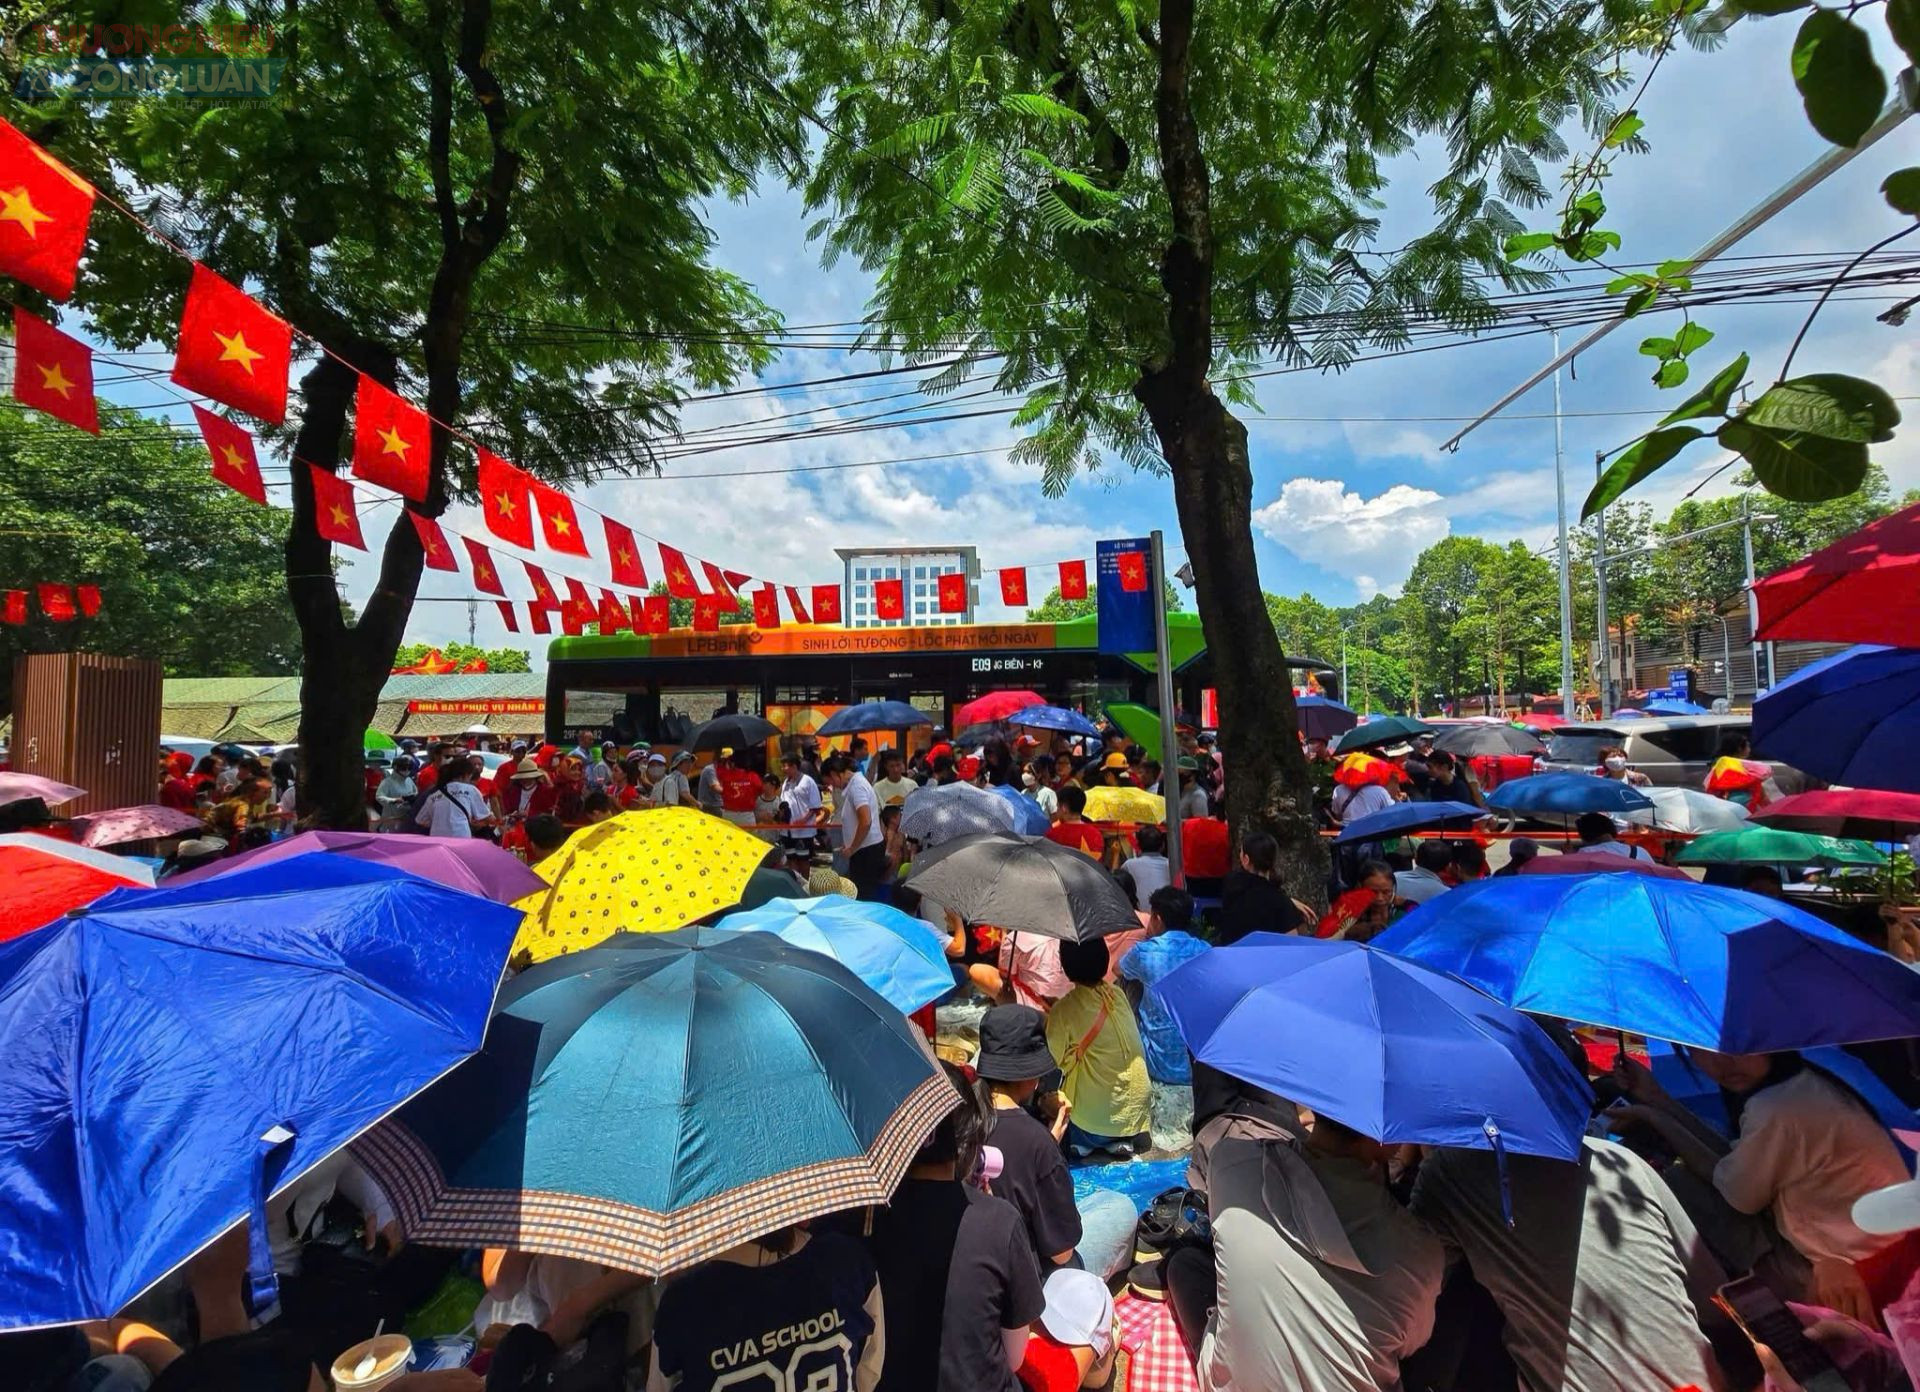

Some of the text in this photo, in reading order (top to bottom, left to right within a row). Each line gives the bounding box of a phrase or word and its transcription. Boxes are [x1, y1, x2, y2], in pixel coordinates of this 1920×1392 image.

[687, 636, 748, 653] LPBank
[803, 639, 830, 650] SINH
[832, 635, 851, 649] LỜI
[972, 658, 991, 671] E09
[709, 1308, 846, 1370] CVA SCHOOL
